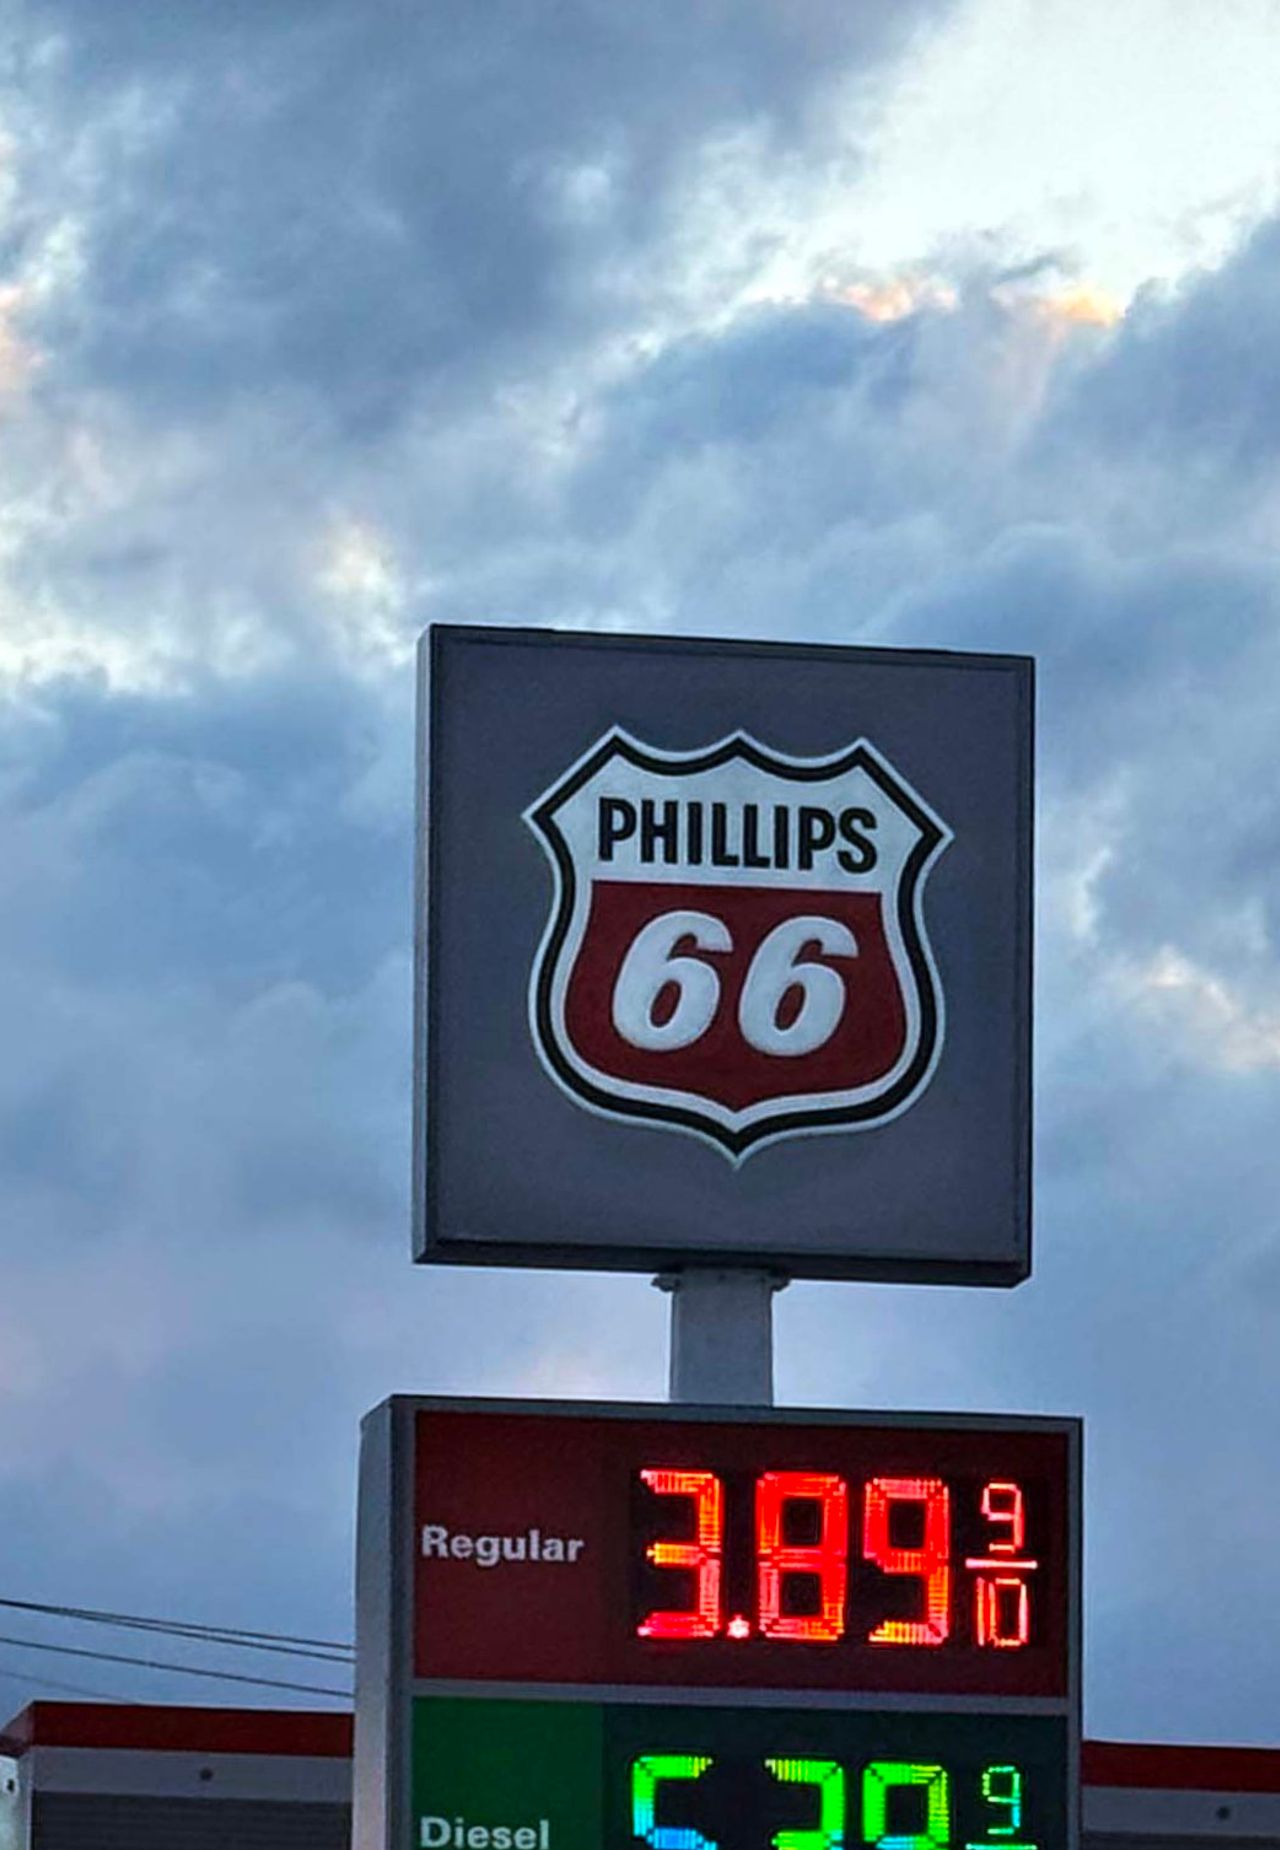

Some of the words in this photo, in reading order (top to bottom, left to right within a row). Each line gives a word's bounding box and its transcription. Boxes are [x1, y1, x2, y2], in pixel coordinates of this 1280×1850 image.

[598, 796, 878, 874] PHILLIPS
[612, 909, 860, 1058] 66
[420, 1525, 585, 1568] Regular
[636, 1467, 950, 1646] 3.89
[420, 1815, 550, 1850] Diesel
